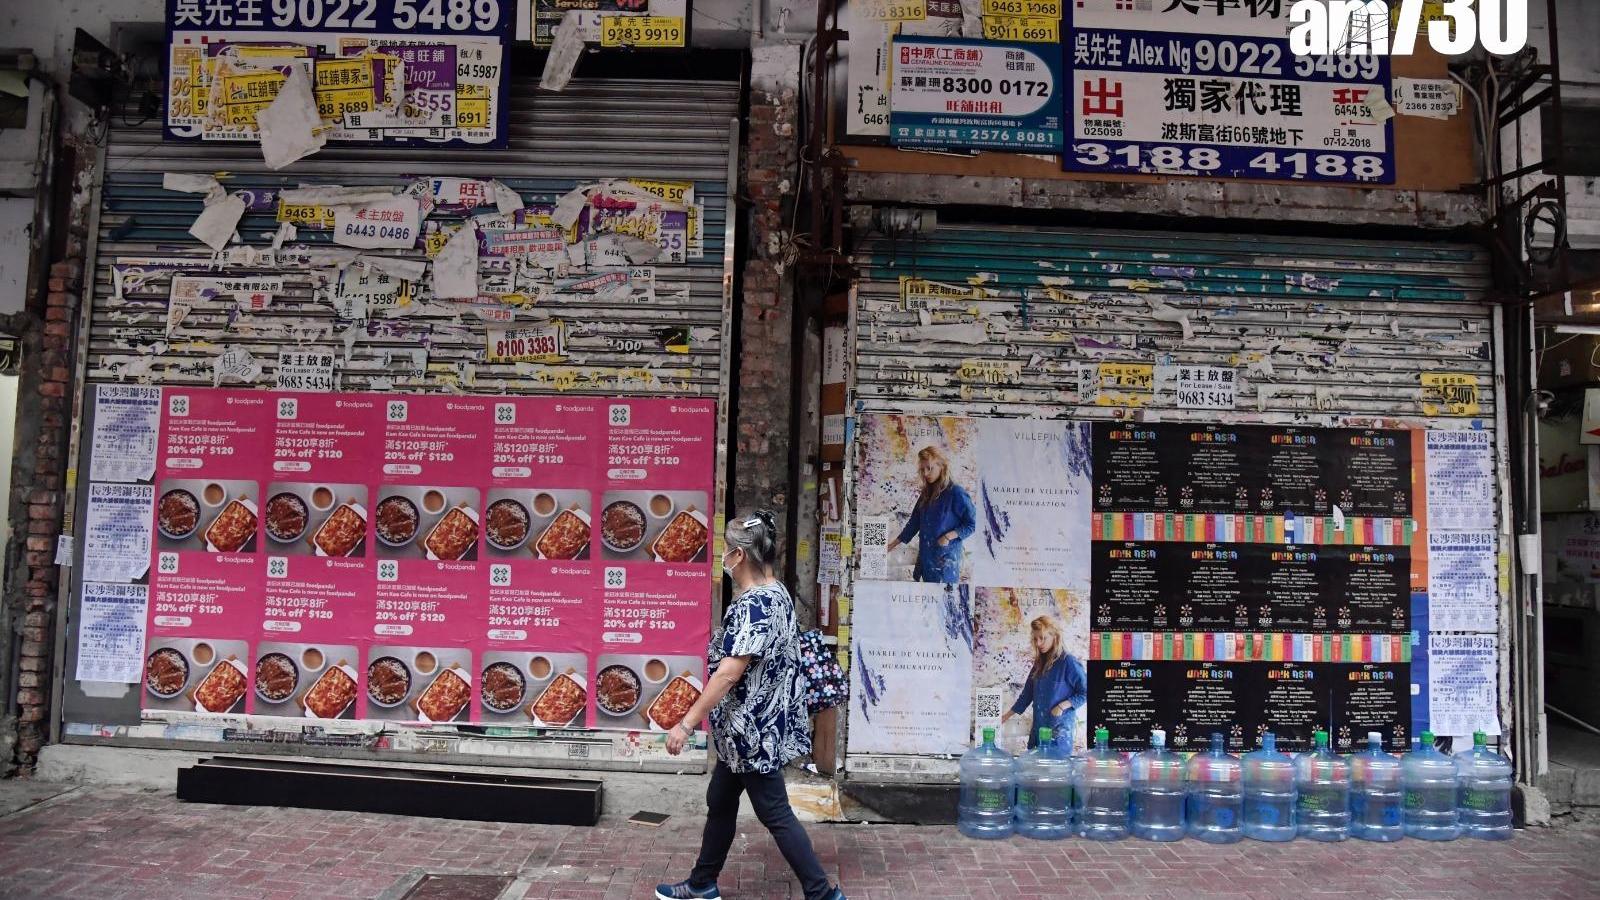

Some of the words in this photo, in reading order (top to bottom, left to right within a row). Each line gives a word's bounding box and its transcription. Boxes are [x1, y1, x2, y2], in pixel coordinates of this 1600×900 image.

[889, 6, 922, 18] 8316
[991, 1, 1022, 13] 9463
[271, 0, 377, 29] 9022
[392, 0, 500, 31] 5489
[644, 28, 680, 41] 9919
[1023, 28, 1054, 39] 6691
[1074, 33, 1122, 66] 吳先生
[1128, 39, 1164, 65] Alex
[1169, 40, 1191, 73] Ng
[1194, 40, 1281, 74] 9022
[472, 64, 498, 79] 5987
[942, 77, 993, 94] 8300
[999, 80, 1049, 97] 0172
[1082, 77, 1124, 118] 出
[1163, 78, 1303, 117] 獨家代理
[970, 130, 1010, 141] 2576
[1016, 131, 1055, 142] 8081
[1083, 127, 1123, 137] 025098
[1161, 122, 1304, 147] 波斯富街66號地下
[1323, 137, 1371, 147] 07-12-2018
[1075, 143, 1222, 171] 3188
[1249, 152, 1385, 177] 4188
[284, 208, 316, 219] 9463
[345, 224, 376, 237] 6443
[379, 226, 410, 240] 0486
[250, 293, 265, 309] 售
[373, 293, 398, 305] 5987
[496, 339, 524, 357] 8100
[527, 336, 556, 355] 3383
[281, 354, 333, 367] 業主放盤
[1180, 369, 1234, 382] 業主放盤
[277, 375, 303, 389] 9683
[305, 376, 331, 390] 5434
[234, 397, 264, 405] foodpanda
[1178, 391, 1205, 406] 9683
[1208, 391, 1233, 406] 5434
[454, 403, 485, 411] foodpanda
[678, 406, 710, 414] foodpanda
[1014, 431, 1061, 441] VILLEPIN
[167, 445, 188, 455] 20%
[209, 446, 234, 455] $120
[384, 451, 406, 460] 20%
[429, 452, 453, 462] $120
[608, 456, 631, 465] 20%
[653, 456, 680, 465] $120
[993, 486, 1020, 494] MARIE
[1039, 488, 1080, 496] VILLEPIN
[224, 556, 254, 564] foodpanda
[444, 563, 476, 571] foodpanda
[674, 569, 706, 578] foodpanda
[891, 594, 939, 604] VILLEPIN
[603, 620, 626, 629] 20%
[649, 620, 676, 630] $120
[868, 649, 896, 657] MARIE
[900, 650, 912, 658] DE
[915, 651, 958, 659] VILLEPIN
[881, 663, 943, 671] MURMURATION
